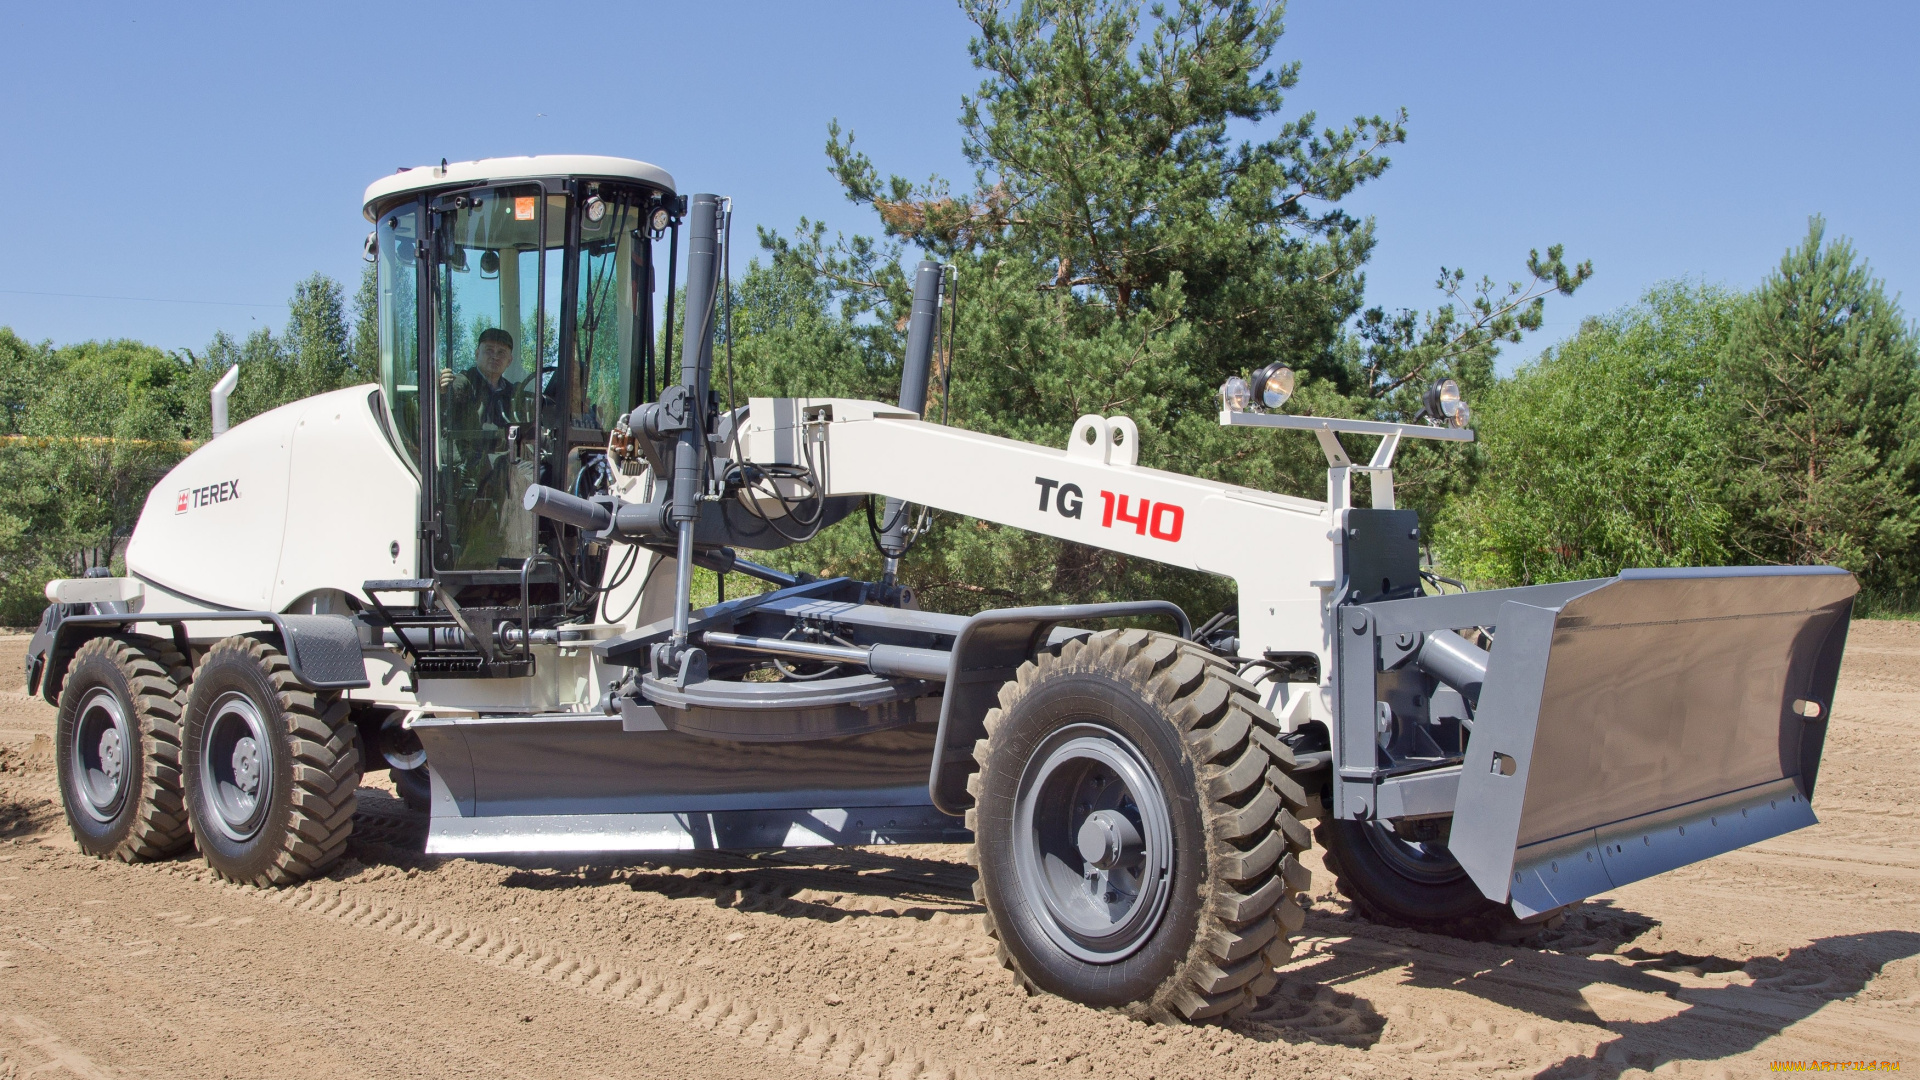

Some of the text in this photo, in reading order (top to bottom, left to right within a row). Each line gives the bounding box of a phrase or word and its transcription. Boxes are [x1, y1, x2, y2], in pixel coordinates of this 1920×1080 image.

[192, 478, 240, 508] TEREX
[1035, 476, 1185, 543] TG 140
